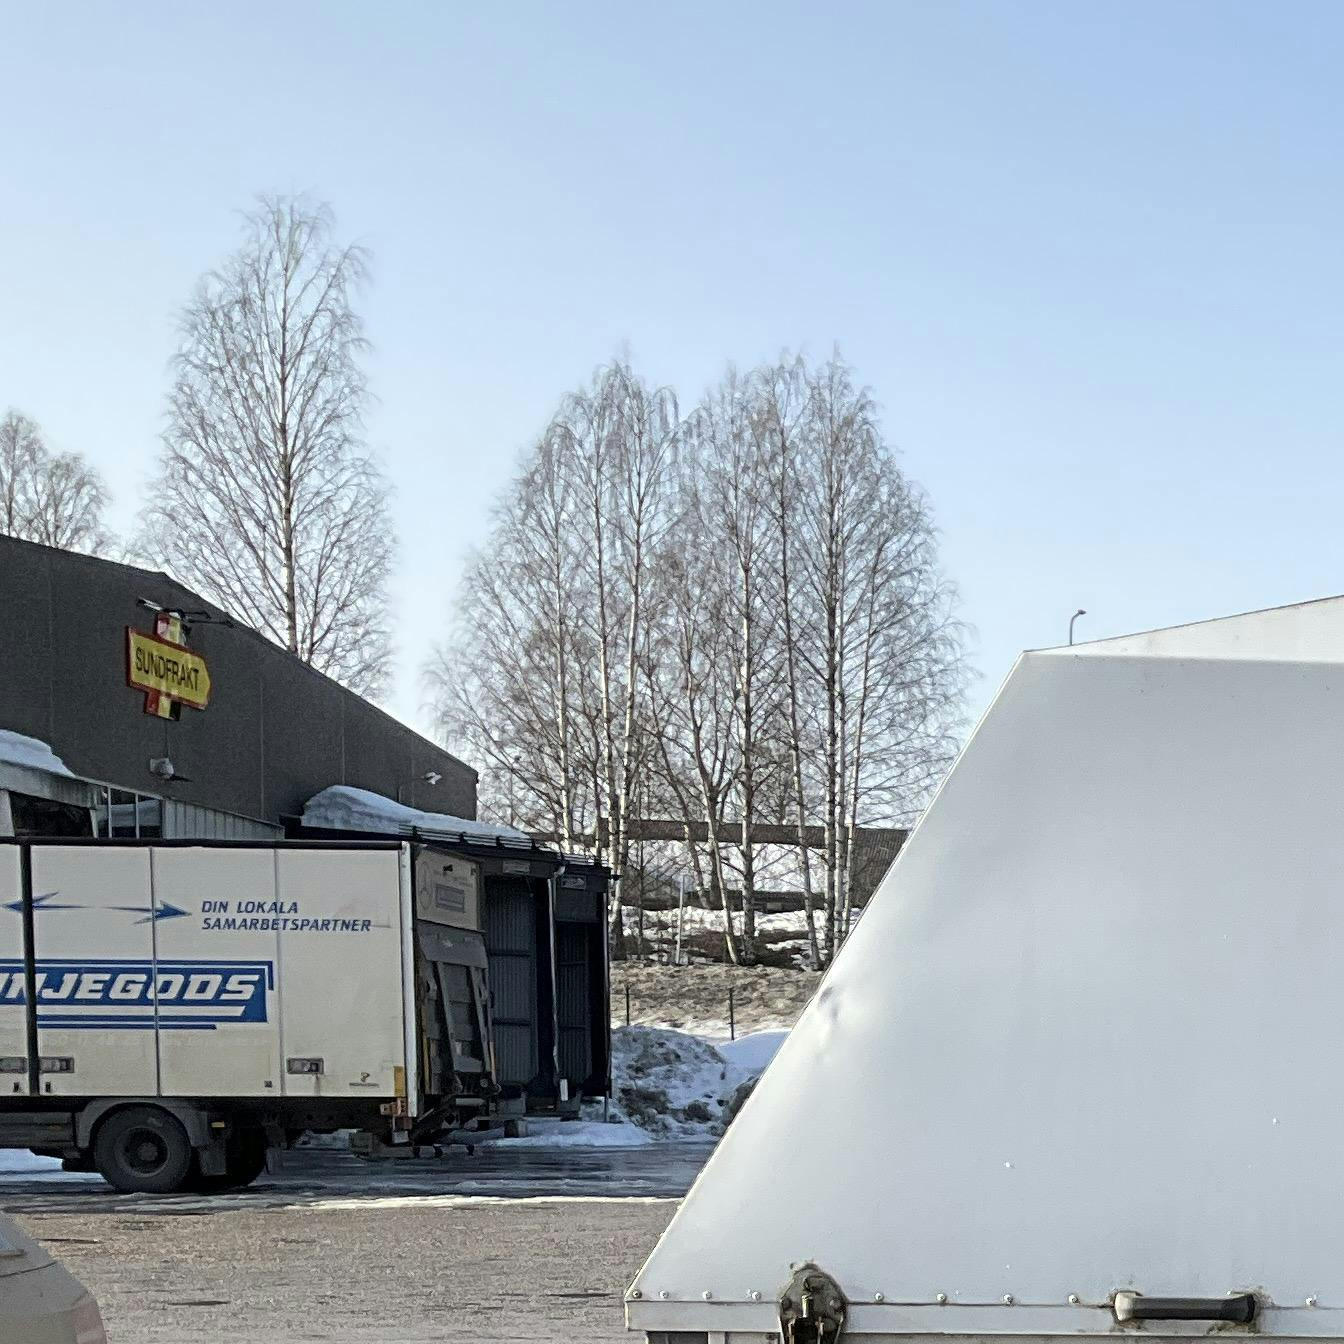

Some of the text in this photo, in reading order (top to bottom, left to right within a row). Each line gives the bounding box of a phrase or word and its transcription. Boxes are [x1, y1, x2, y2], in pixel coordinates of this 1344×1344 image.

[135, 646, 199, 692] SUNDFRAKT
[201, 900, 299, 914] DIN LOKALA
[201, 917, 372, 932] SAMARBETSPARTNER
